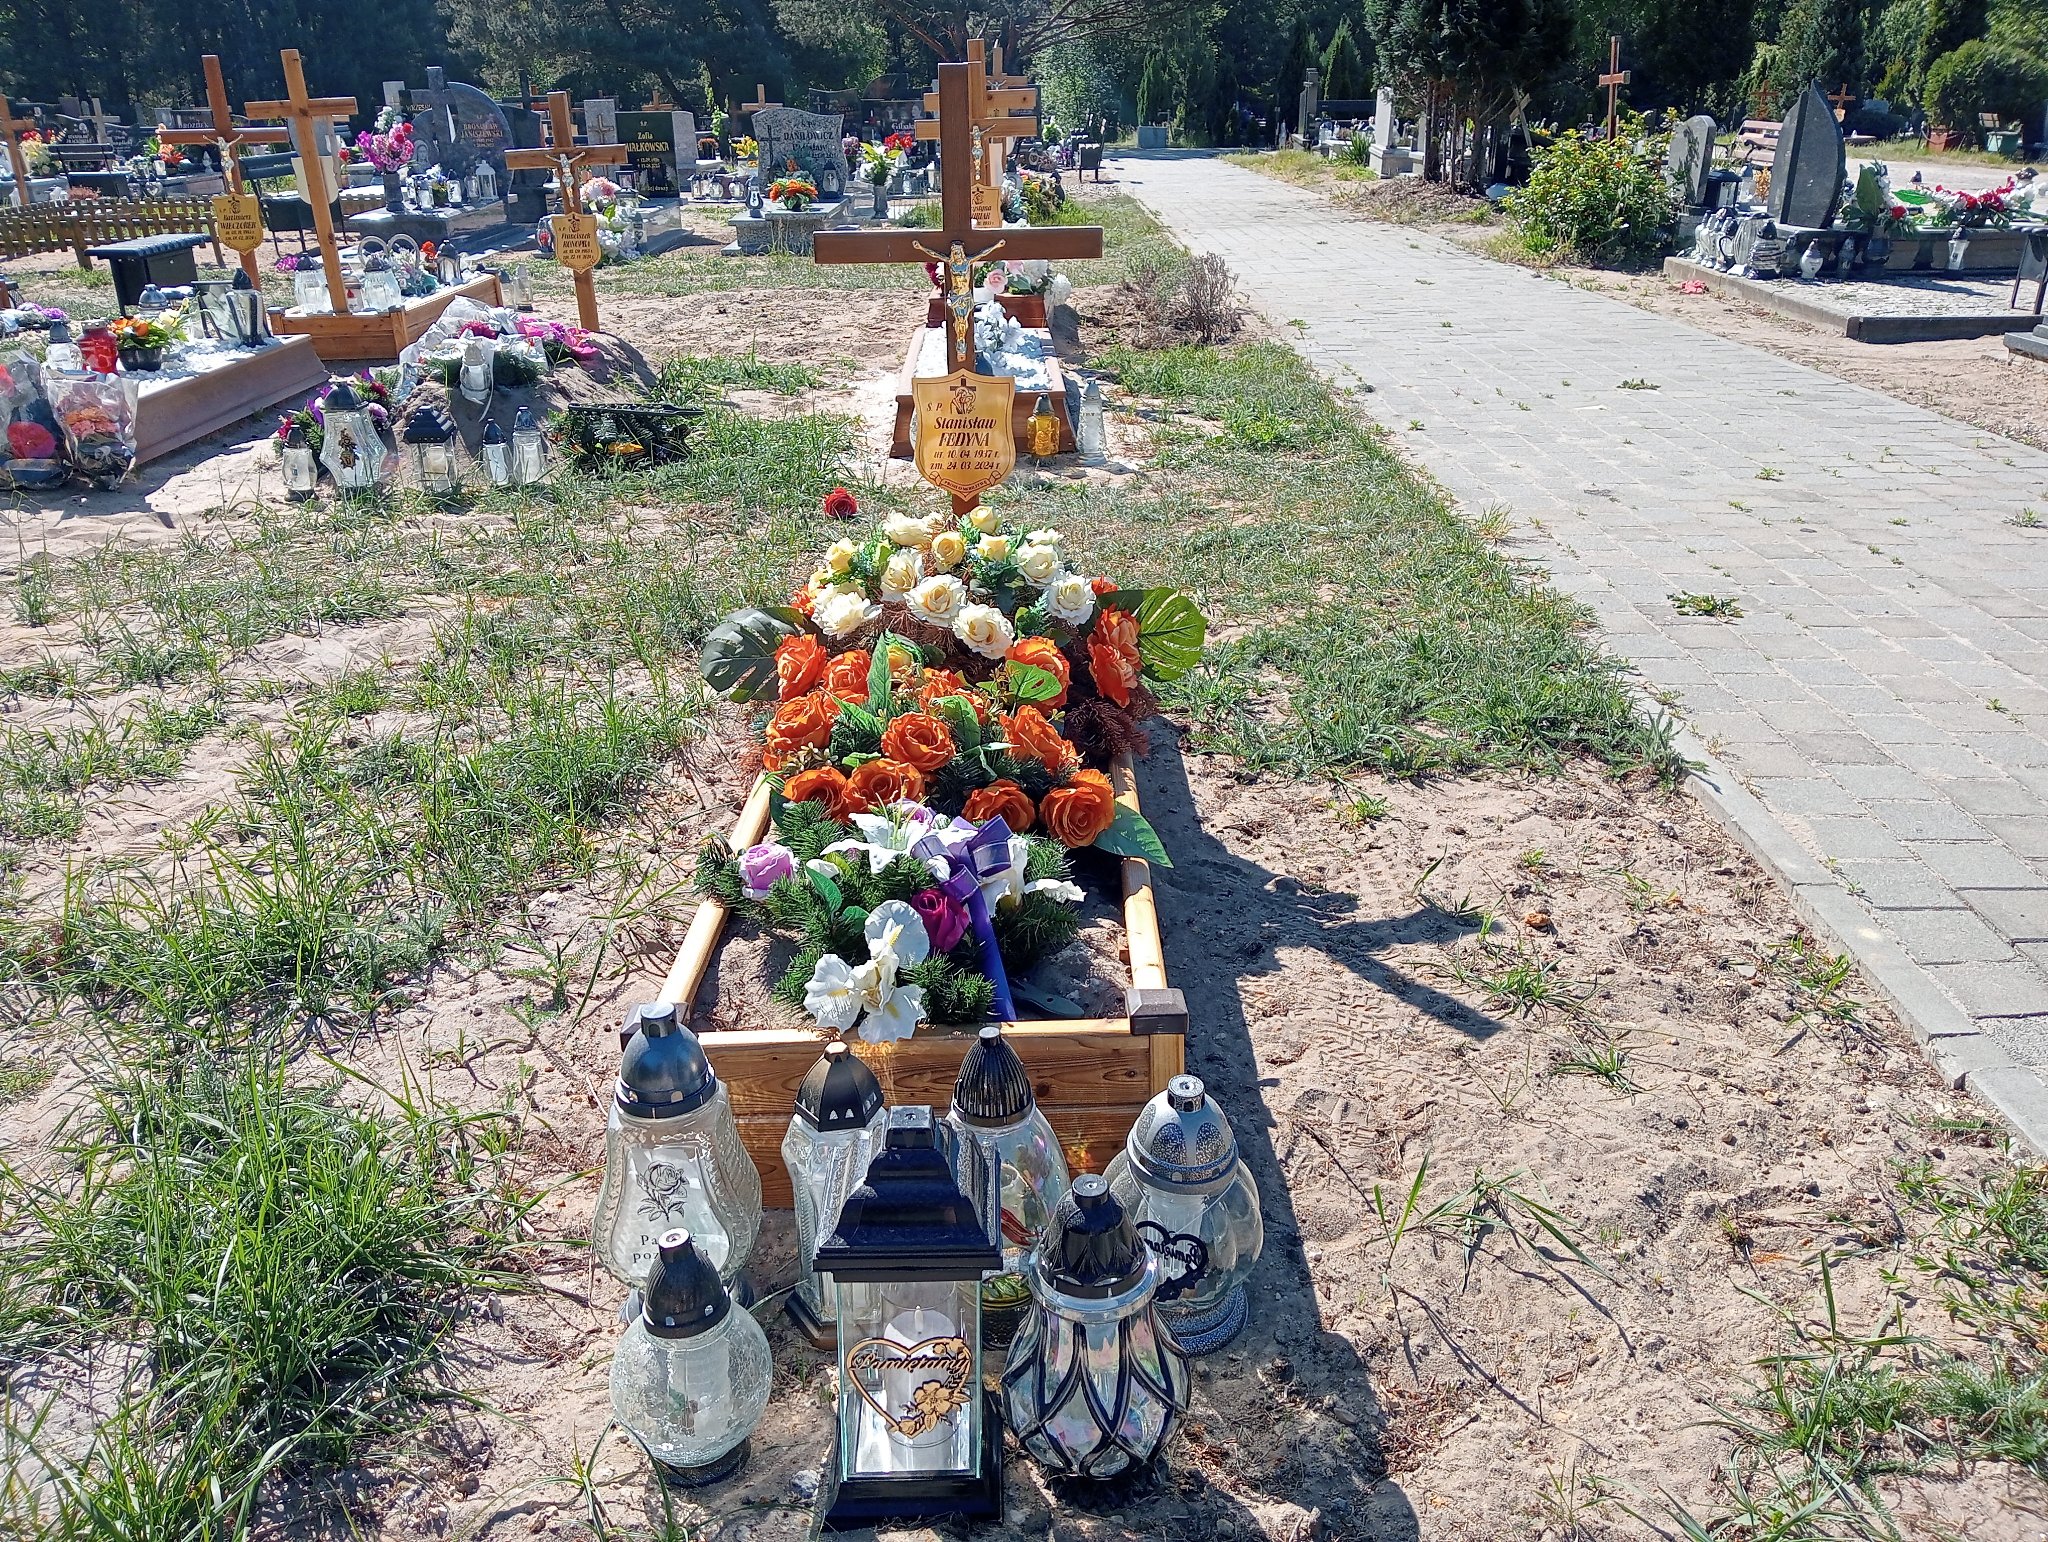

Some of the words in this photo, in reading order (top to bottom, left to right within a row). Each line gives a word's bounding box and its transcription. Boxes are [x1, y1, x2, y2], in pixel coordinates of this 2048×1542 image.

[934, 416, 996, 429] Stanisław
[938, 432, 990, 446] FEDYNA
[974, 450, 992, 458] 1937
[974, 462, 994, 470] 2024
[640, 1233, 696, 1246] Pać
[850, 1353, 970, 1376] Pamiętamy
